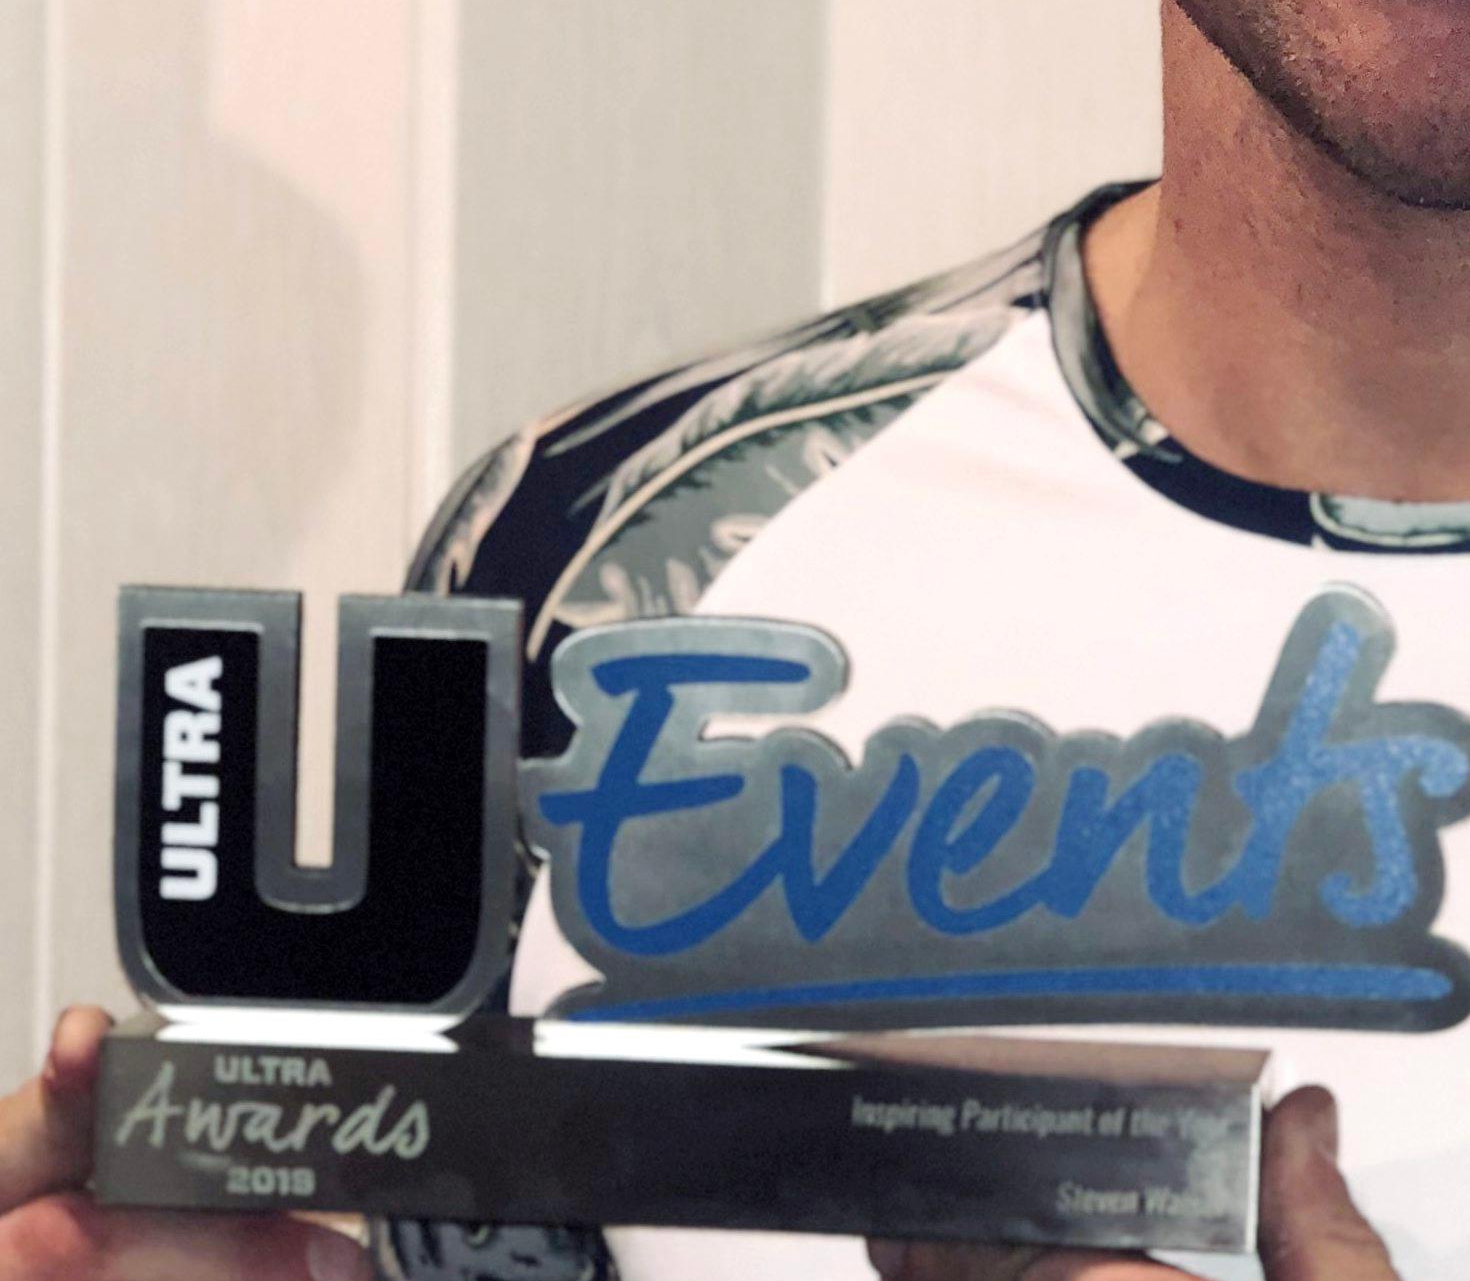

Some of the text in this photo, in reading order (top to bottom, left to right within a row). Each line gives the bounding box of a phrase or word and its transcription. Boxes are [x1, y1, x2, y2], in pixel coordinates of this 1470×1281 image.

[158, 655, 223, 901] ULTRA
[538, 622, 1470, 956] Events
[116, 1061, 431, 1159] Awards
[214, 1055, 331, 1086] ULTRA
[852, 1095, 954, 1137] Inspiring
[961, 1097, 1093, 1139] Participant
[1099, 1107, 1129, 1137] of
